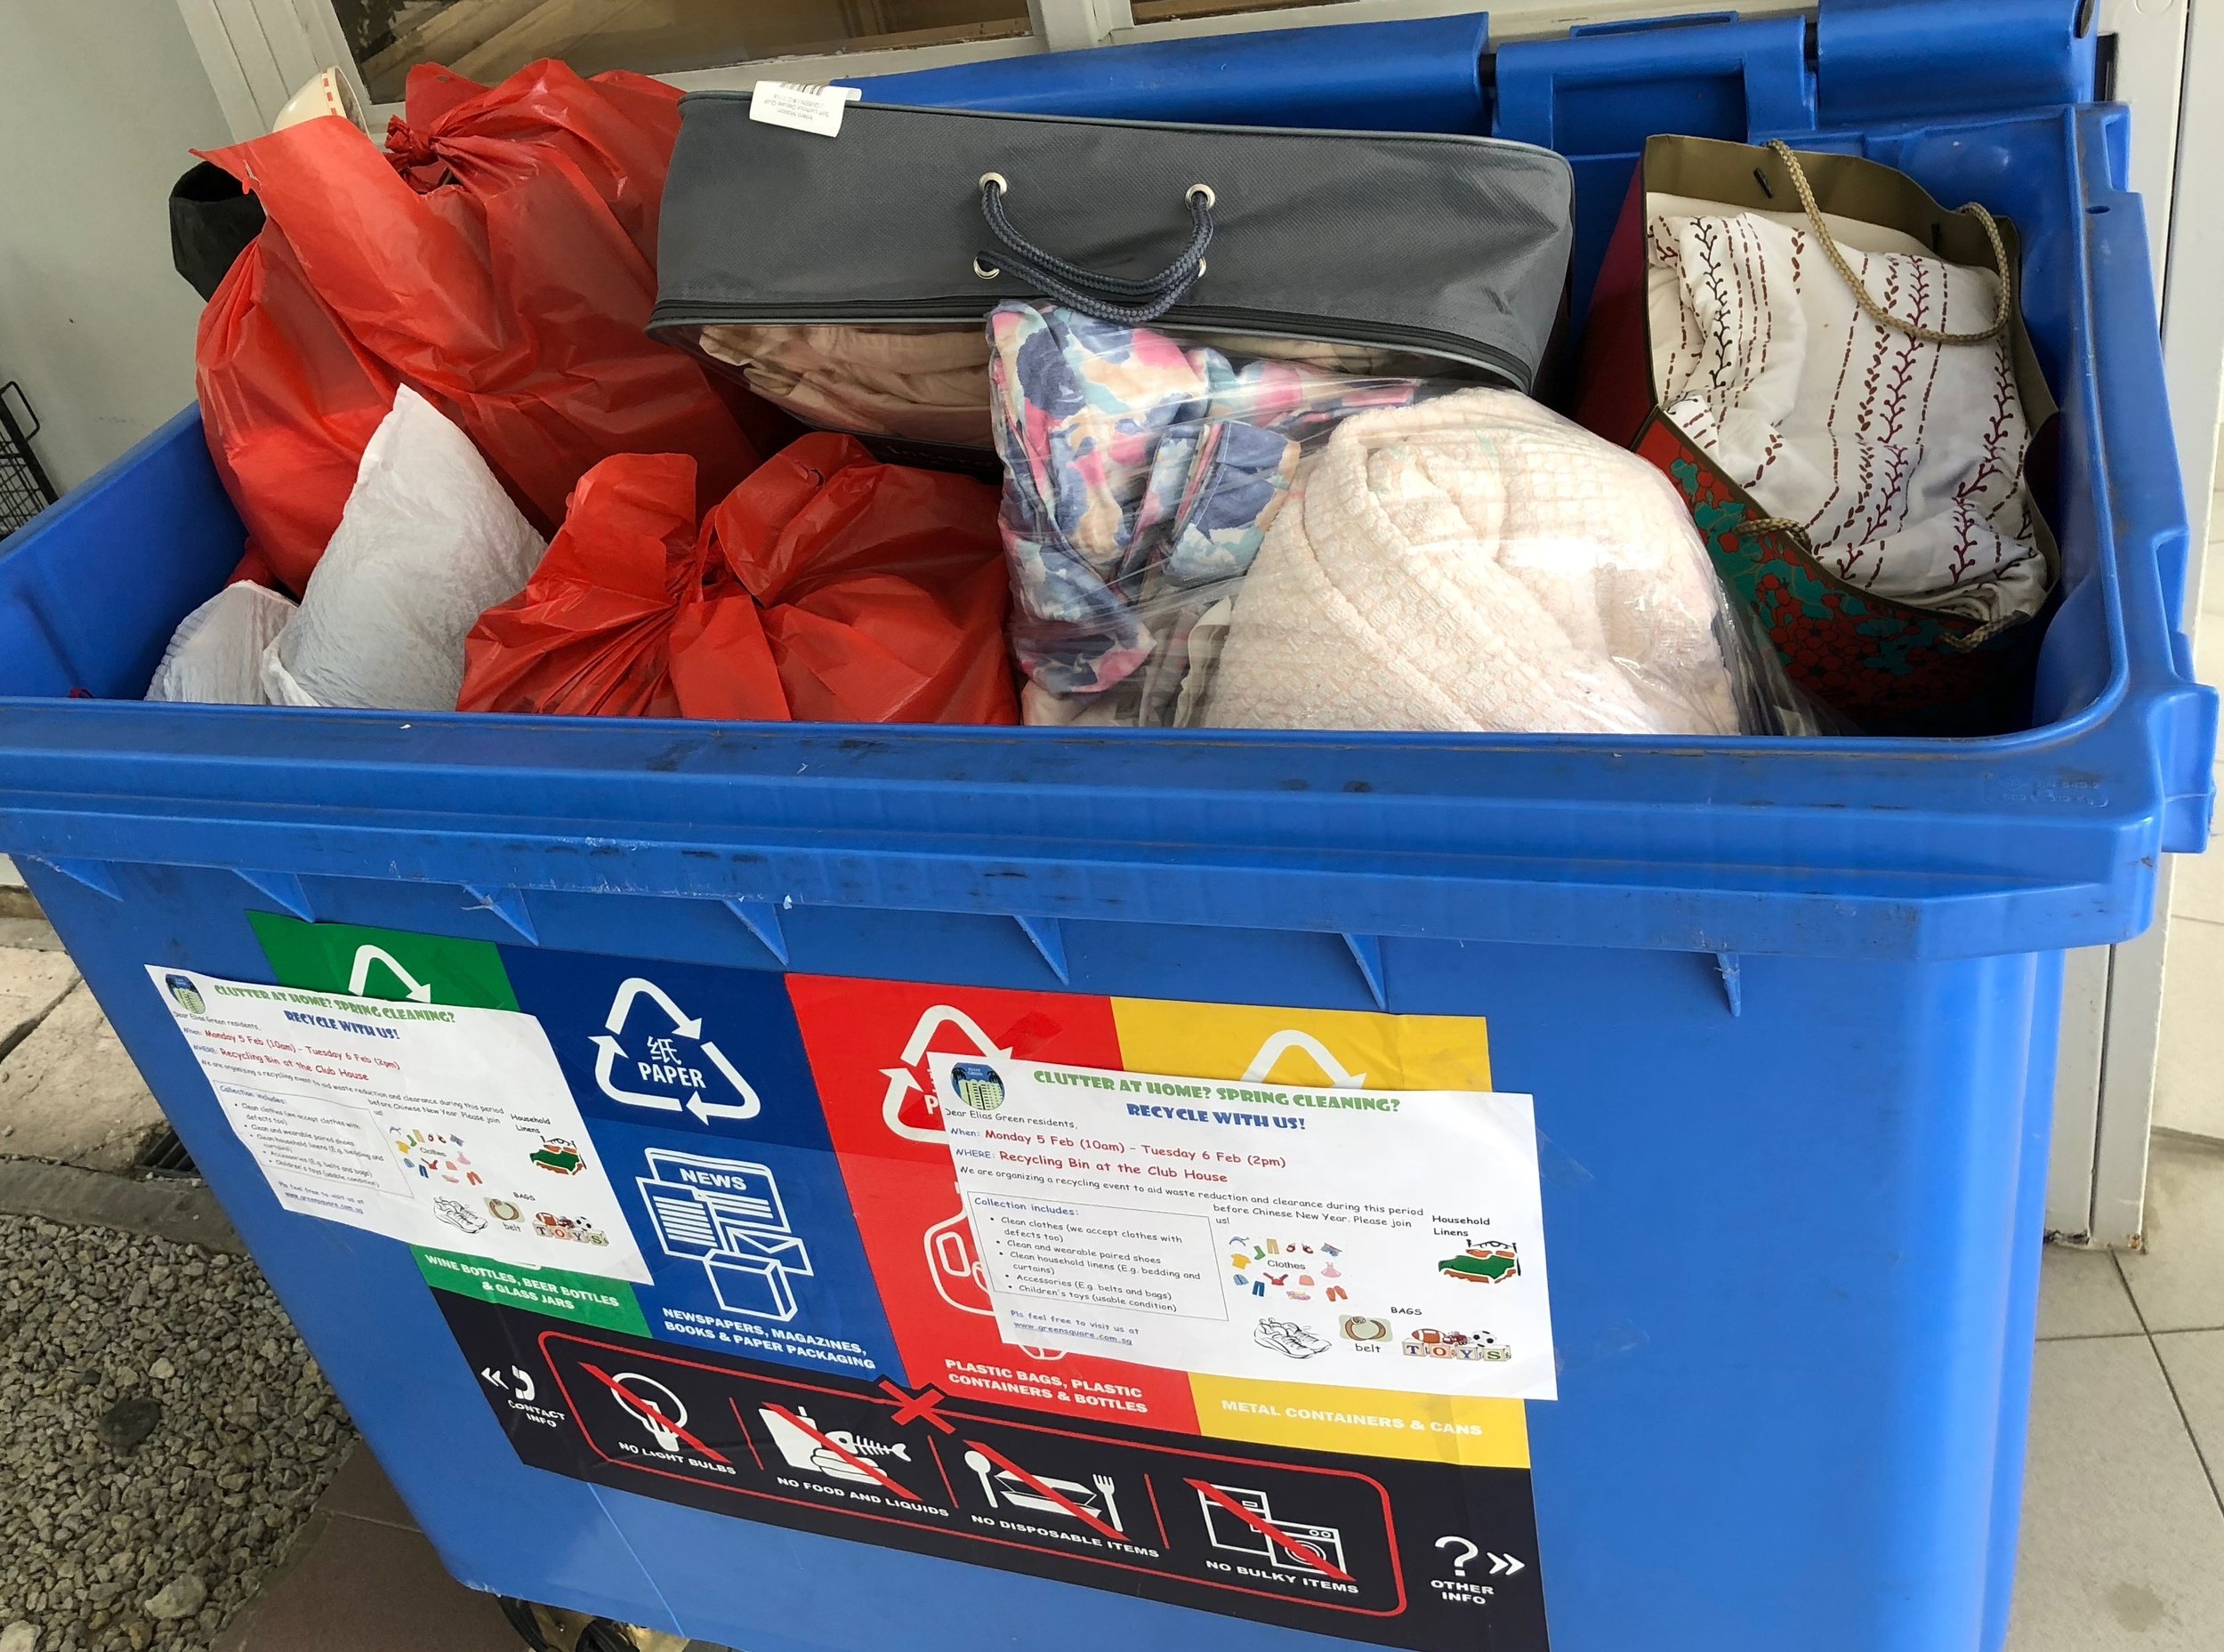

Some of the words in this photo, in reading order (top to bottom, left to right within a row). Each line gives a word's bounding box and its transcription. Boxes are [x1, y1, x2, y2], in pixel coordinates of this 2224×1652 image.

[214, 984, 271, 1000] CLUTTER
[270, 991, 287, 1002] AT
[286, 993, 333, 1009] HOME?
[333, 999, 383, 1018] SPRING
[382, 1007, 455, 1023] CLEANING?
[283, 1010, 338, 1030] RECYCLE
[337, 1019, 376, 1036] WITH
[375, 1027, 400, 1040] US!
[204, 1029, 236, 1044] Monday
[238, 1035, 246, 1043] 5
[246, 1036, 264, 1046] Feb
[265, 1038, 296, 1053] (10am)
[304, 1045, 342, 1060] Tuesday
[344, 1052, 352, 1060] 6
[353, 1053, 372, 1064] Feb
[374, 1057, 400, 1070] (2pm)
[647, 1036, 681, 1065] 纸
[638, 1062, 706, 1088] PAPER
[1033, 1070, 1115, 1091] CLUTTER
[1119, 1079, 1142, 1092] AT
[1145, 1082, 1212, 1100] HOME?
[1215, 1087, 1289, 1106] SPRING
[1292, 1094, 1400, 1112] CLEANING?
[969, 1109, 993, 1120] Elias
[995, 1113, 1025, 1123] Green
[1027, 1118, 1077, 1129] residents,
[1125, 1103, 1209, 1123] RECYCLE
[1212, 1111, 1269, 1127] WITH
[1271, 1116, 1305, 1130] US!
[985, 1129, 1031, 1145] Monday
[1036, 1134, 1045, 1144] 5
[1050, 1135, 1075, 1147] Feb
[1079, 1139, 1124, 1154] (10am)
[1140, 1144, 1196, 1161] Tuesday
[1202, 1150, 1211, 1160] 6
[1216, 1151, 1241, 1163] Feb
[1246, 1155, 1285, 1168] (2pm)
[680, 1168, 746, 1190] NEWS
[999, 1150, 1063, 1169] Recycling
[1068, 1157, 1090, 1170] Bin
[1095, 1162, 1111, 1172] at
[1116, 1163, 1141, 1174] the
[1148, 1165, 1178, 1178] Club
[1183, 1168, 1228, 1182] House
[959, 1165, 975, 1174] We
[995, 1171, 1044, 1184] organizing
[1055, 1178, 1100, 1189] recycling
[1102, 1182, 1130, 1191] event
[1132, 1184, 1145, 1192] to
[1164, 1189, 1196, 1197] waste
[1197, 1191, 1248, 1202] reduction
[1272, 1197, 1323, 1208] clearance
[1326, 1201, 1360, 1213] during
[1363, 1204, 1385, 1213] this
[1388, 1207, 1423, 1216] period
[974, 1197, 1027, 1210] Collection
[1030, 1204, 1078, 1216] includes:
[1213, 1203, 1249, 1214] before
[1252, 1207, 1293, 1218] Chinese
[1295, 1211, 1319, 1220] New
[1353, 1215, 1388, 1226] Please
[1390, 1218, 1412, 1229] join
[1431, 1214, 1490, 1226] Household
[1001, 1216, 1027, 1226] Clean
[1028, 1220, 1064, 1230] clothes
[1066, 1223, 1084, 1233] (we
[1085, 1228, 1118, 1237] accept
[1121, 1230, 1157, 1241] clothes
[1159, 1235, 1182, 1243] with
[1003, 1228, 1041, 1239] defects
[1044, 1233, 1064, 1243] too)
[1433, 1228, 1469, 1237] Linens
[1006, 1239, 1032, 1249] Clean
[1034, 1244, 1052, 1252] and
[1052, 1247, 1097, 1257] wearable
[1099, 1252, 1131, 1261] paired
[1132, 1254, 1161, 1264] shoes
[1267, 1259, 1306, 1270] Clothes
[1010, 1251, 1035, 1261] Clean
[1036, 1254, 1084, 1267] household
[1086, 1260, 1115, 1270] linens
[1140, 1266, 1180, 1279] bedding
[1182, 1272, 1201, 1280] and
[1012, 1263, 1055, 1276] curtains)
[424, 1254, 460, 1271] WINE
[460, 1263, 521, 1286] BOTTLES,
[521, 1277, 559, 1293] BEER
[560, 1285, 619, 1307] BOTTLES
[1016, 1274, 1072, 1287] Accessories
[1097, 1284, 1123, 1293] belts
[1125, 1288, 1143, 1296] and
[1144, 1289, 1172, 1301] bags)
[481, 1281, 495, 1291] &
[495, 1284, 539, 1301] GLASS
[542, 1294, 575, 1310] JARS
[1019, 1284, 1067, 1297] Children's
[1068, 1292, 1090, 1301] toys
[1092, 1293, 1126, 1305] (usable
[1128, 1300, 1177, 1312] condition)
[1010, 1310, 1024, 1318] Pls
[1027, 1312, 1047, 1321] feel
[1050, 1315, 1071, 1325] free
[1089, 1322, 1109, 1330] visit
[1390, 1306, 1422, 1316] BAGS
[662, 1307, 769, 1338] NEWSPAPERS,
[770, 1328, 866, 1356] MAGAZINES,
[664, 1320, 715, 1339] BOOKS
[719, 1332, 731, 1342] &
[732, 1334, 784, 1352] PAPER
[786, 1344, 876, 1369] PACKAGING
[1355, 1342, 1381, 1353] belt
[945, 1358, 1012, 1378] PLASTIC
[1016, 1370, 1068, 1390] BAGS,
[1070, 1379, 1142, 1398] PLASTIC
[948, 1374, 1053, 1398] CONTAINERS
[1057, 1390, 1071, 1402] &
[1074, 1393, 1148, 1413] BOTTLES
[507, 1399, 565, 1420] CONTACT
[526, 1413, 557, 1428] INFO
[1221, 1400, 1281, 1416] METAL
[1285, 1407, 1405, 1429] CONTAINERS
[1409, 1419, 1425, 1430] &
[1430, 1422, 1482, 1436] CANS
[618, 1441, 639, 1454] NO
[641, 1447, 684, 1463] LIGHT
[688, 1458, 736, 1474] BULBS
[777, 1477, 800, 1487] NO
[802, 1482, 845, 1496] FOOD
[850, 1491, 882, 1503] AND
[884, 1497, 949, 1517] LIQUIDS
[971, 1515, 995, 1526] NO
[999, 1520, 1102, 1547] DISPOSABLE
[1107, 1541, 1159, 1558] ITEMS
[1205, 1560, 1231, 1571] NO
[1237, 1566, 1296, 1584] BULKY
[1302, 1577, 1358, 1593] ITEMS
[1430, 1580, 1494, 1594] OTHER
[1441, 1592, 1486, 1604] INFO
